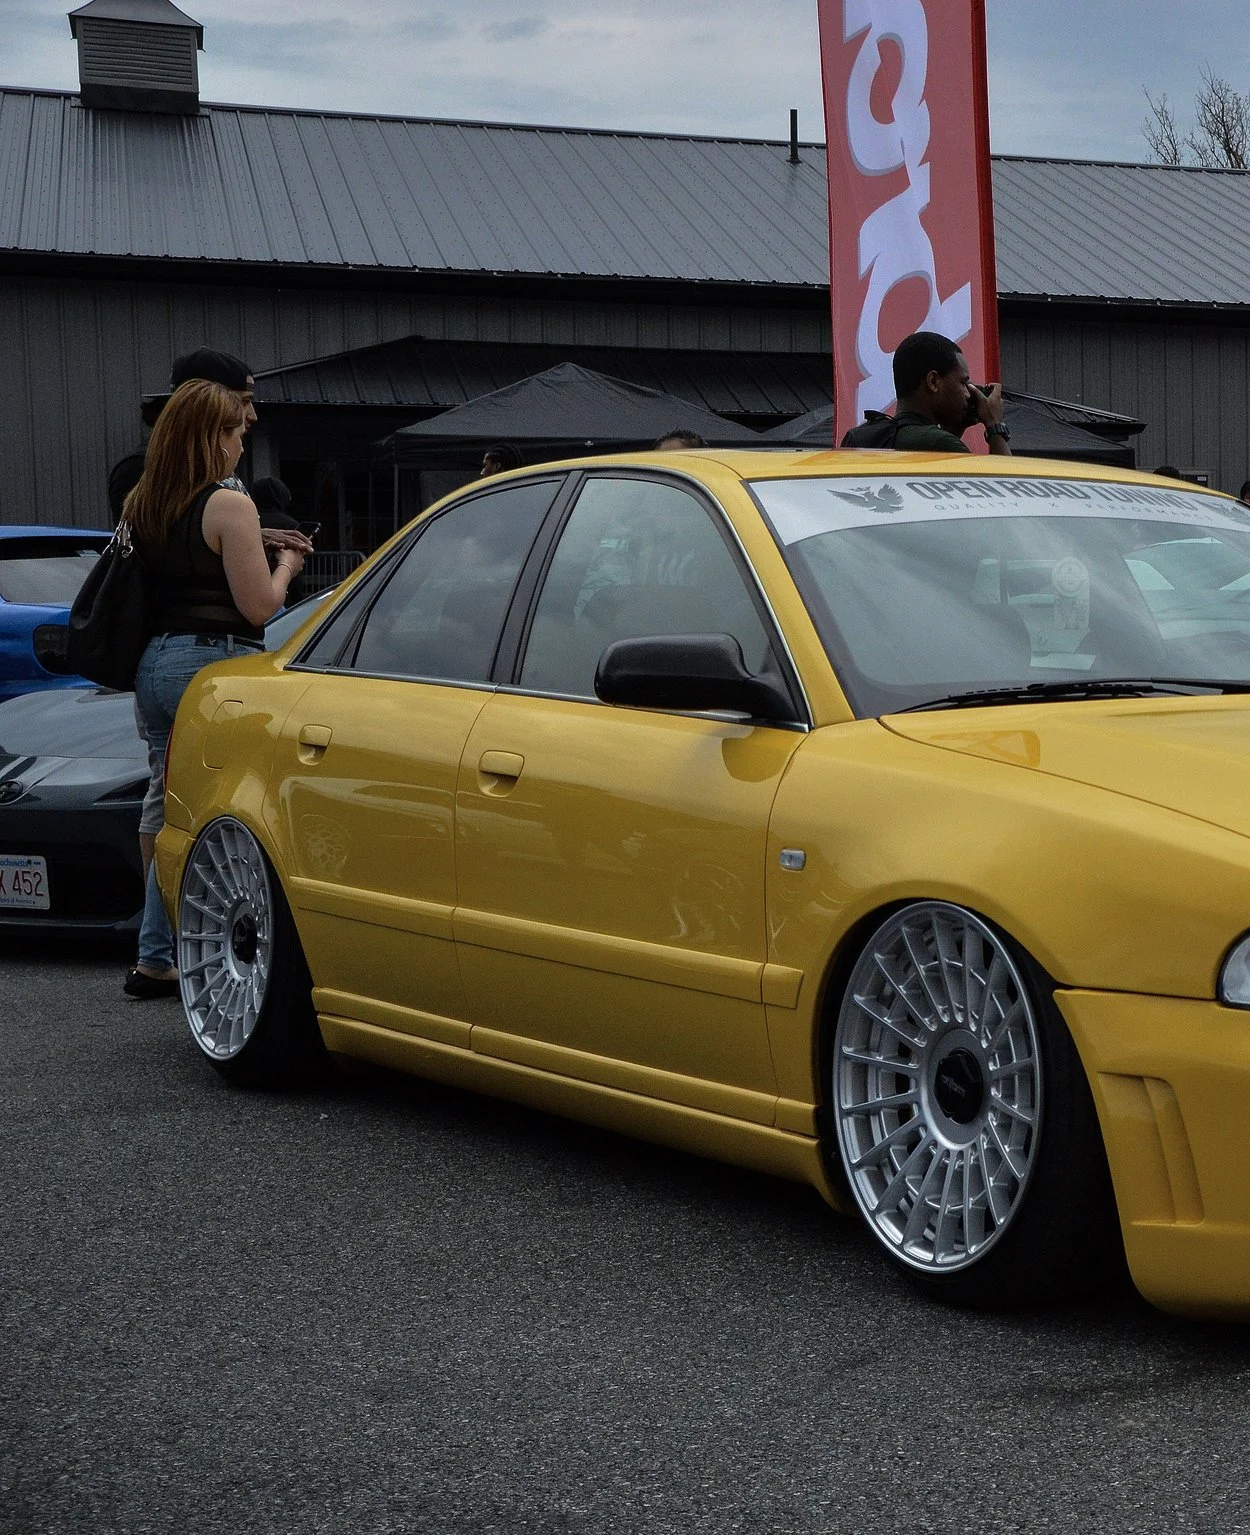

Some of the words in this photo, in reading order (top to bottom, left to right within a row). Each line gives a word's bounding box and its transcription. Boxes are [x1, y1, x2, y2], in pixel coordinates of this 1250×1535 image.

[906, 480, 1006, 500] OPEN
[993, 480, 1092, 500] ROAD
[1079, 485, 1199, 512] TUNING
[934, 502, 1019, 511] QUALITY
[12, 870, 44, 897] 452
